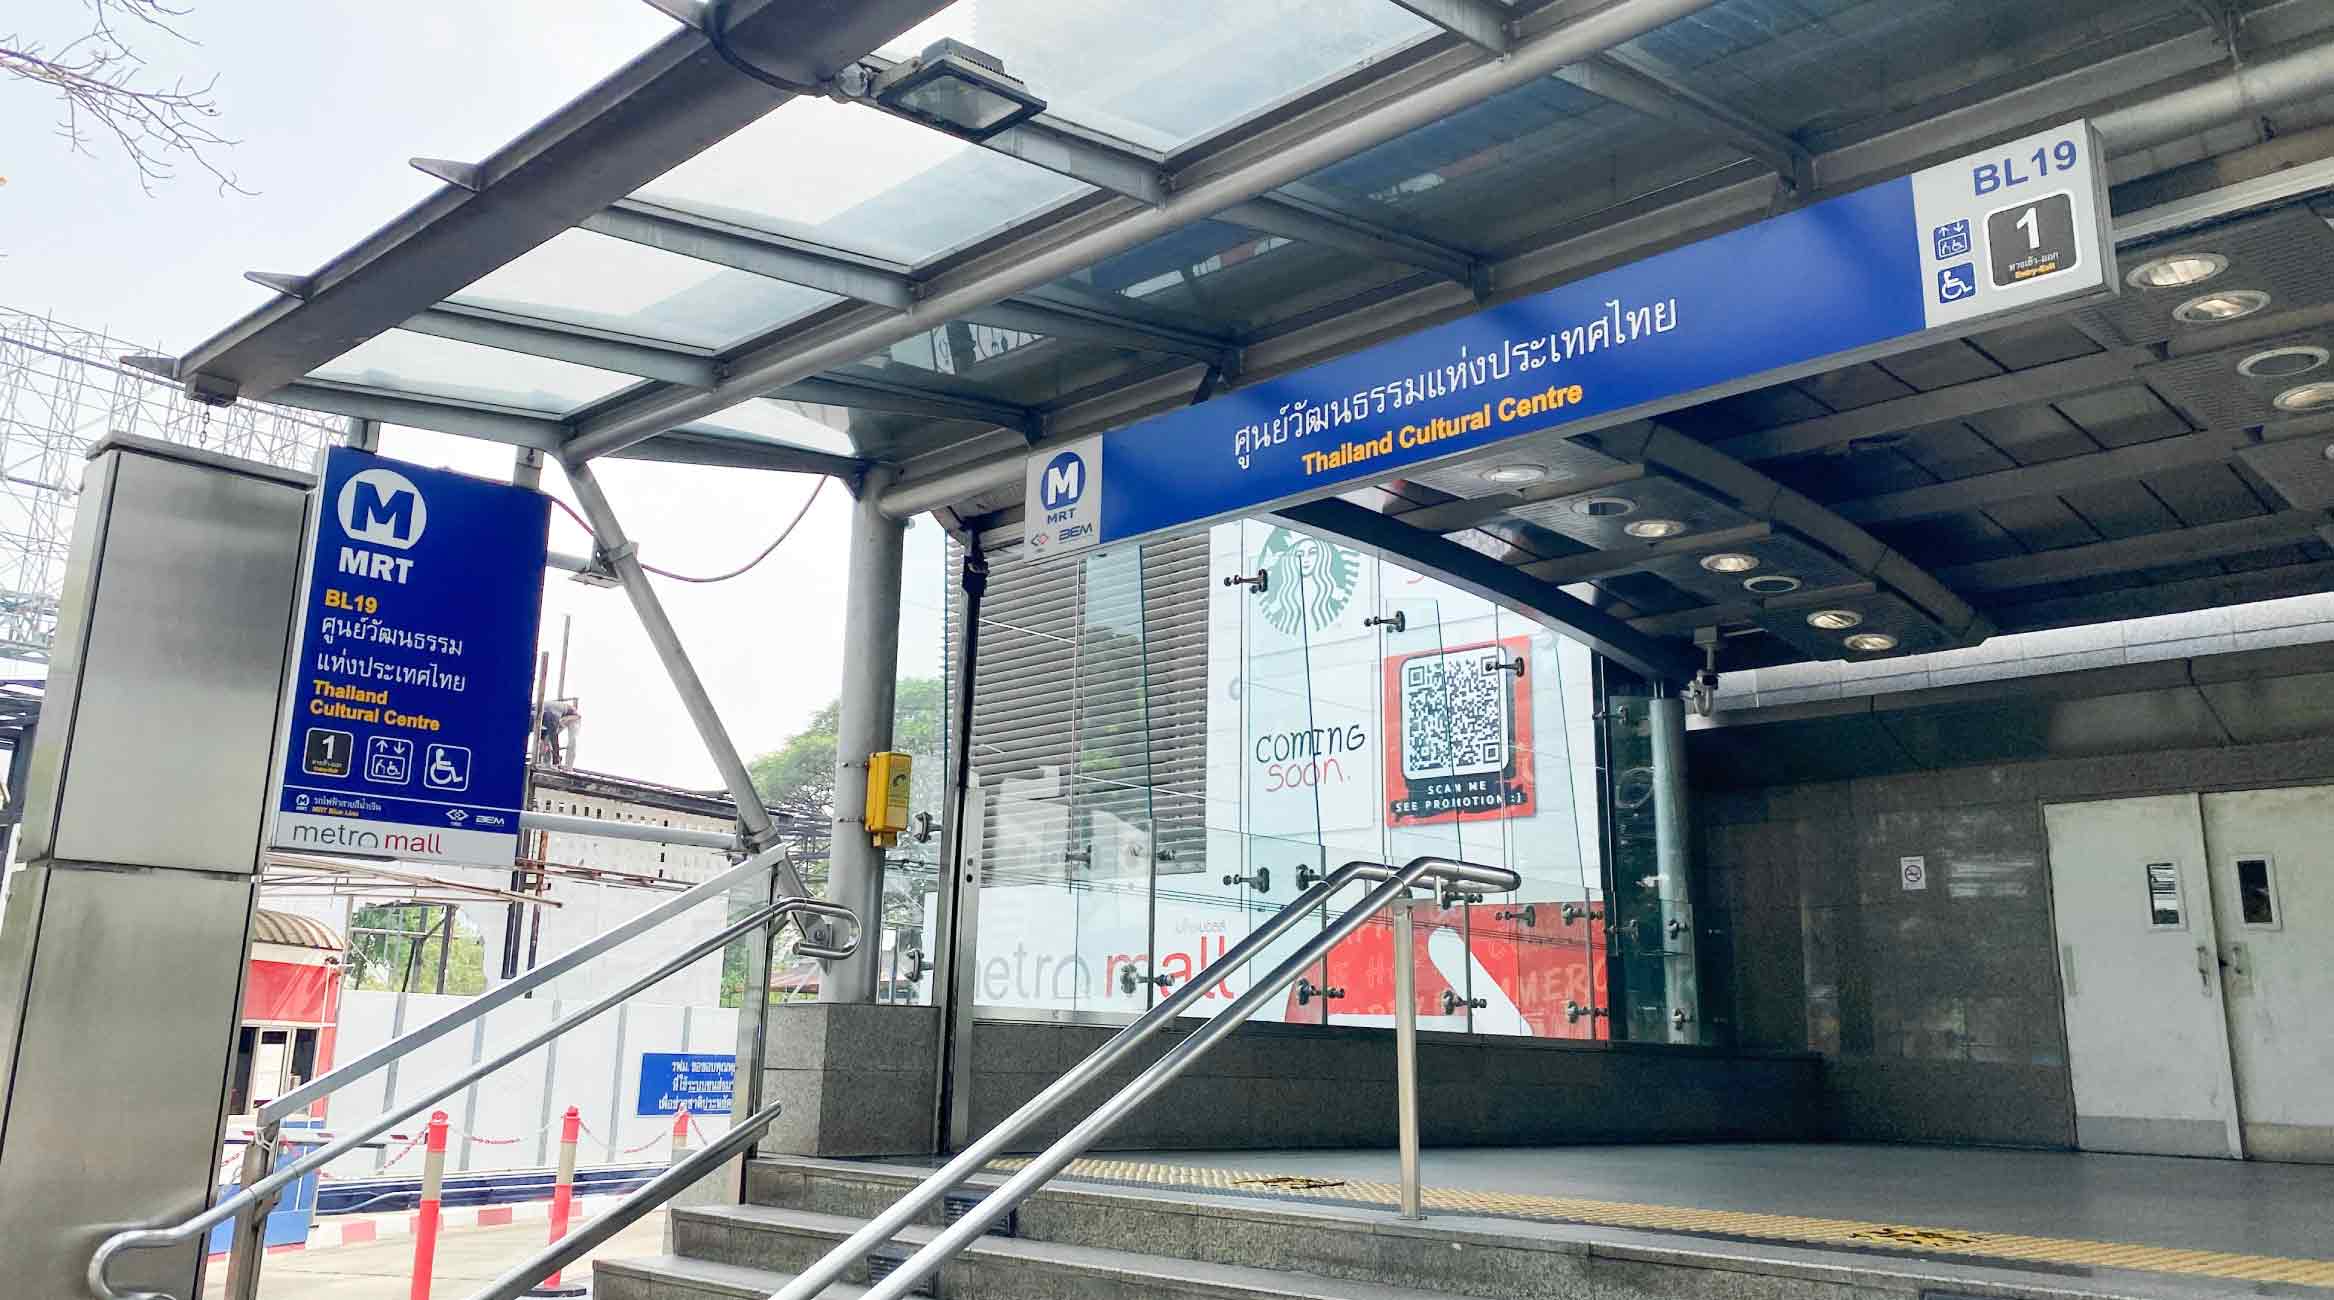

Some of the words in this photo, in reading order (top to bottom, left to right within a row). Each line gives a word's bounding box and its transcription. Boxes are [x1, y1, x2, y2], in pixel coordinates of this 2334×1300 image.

[1973, 140, 2077, 196] BL19
[2016, 207, 2040, 249] 1
[1234, 299, 1678, 469] ศูนย์วัฒนธรรมแห่งประเทศไทย
[1301, 430, 1393, 476] Thailand
[1399, 405, 1491, 449] Cultural
[1498, 383, 1584, 422] Centre
[1047, 508, 1077, 524] MRT
[1058, 522, 1093, 541] BEM
[338, 546, 414, 584] MRT
[325, 588, 378, 614] BL19
[321, 616, 463, 656] ศูนย์วัฒนธรรม
[317, 648, 466, 692] แห่งประเทศไทย
[313, 679, 389, 705] Thailand
[310, 699, 379, 723] Cultural
[383, 709, 441, 731] Centre
[322, 735, 335, 759] 1
[1427, 782, 1462, 796] SCAN
[1469, 780, 1487, 792] ME
[1395, 800, 1418, 813] SEE
[1425, 795, 1505, 810] PROMOTION
[475, 815, 505, 825] BEM
[292, 825, 379, 849] metro
[384, 832, 443, 855] mall
[974, 941, 1092, 1001] etro
